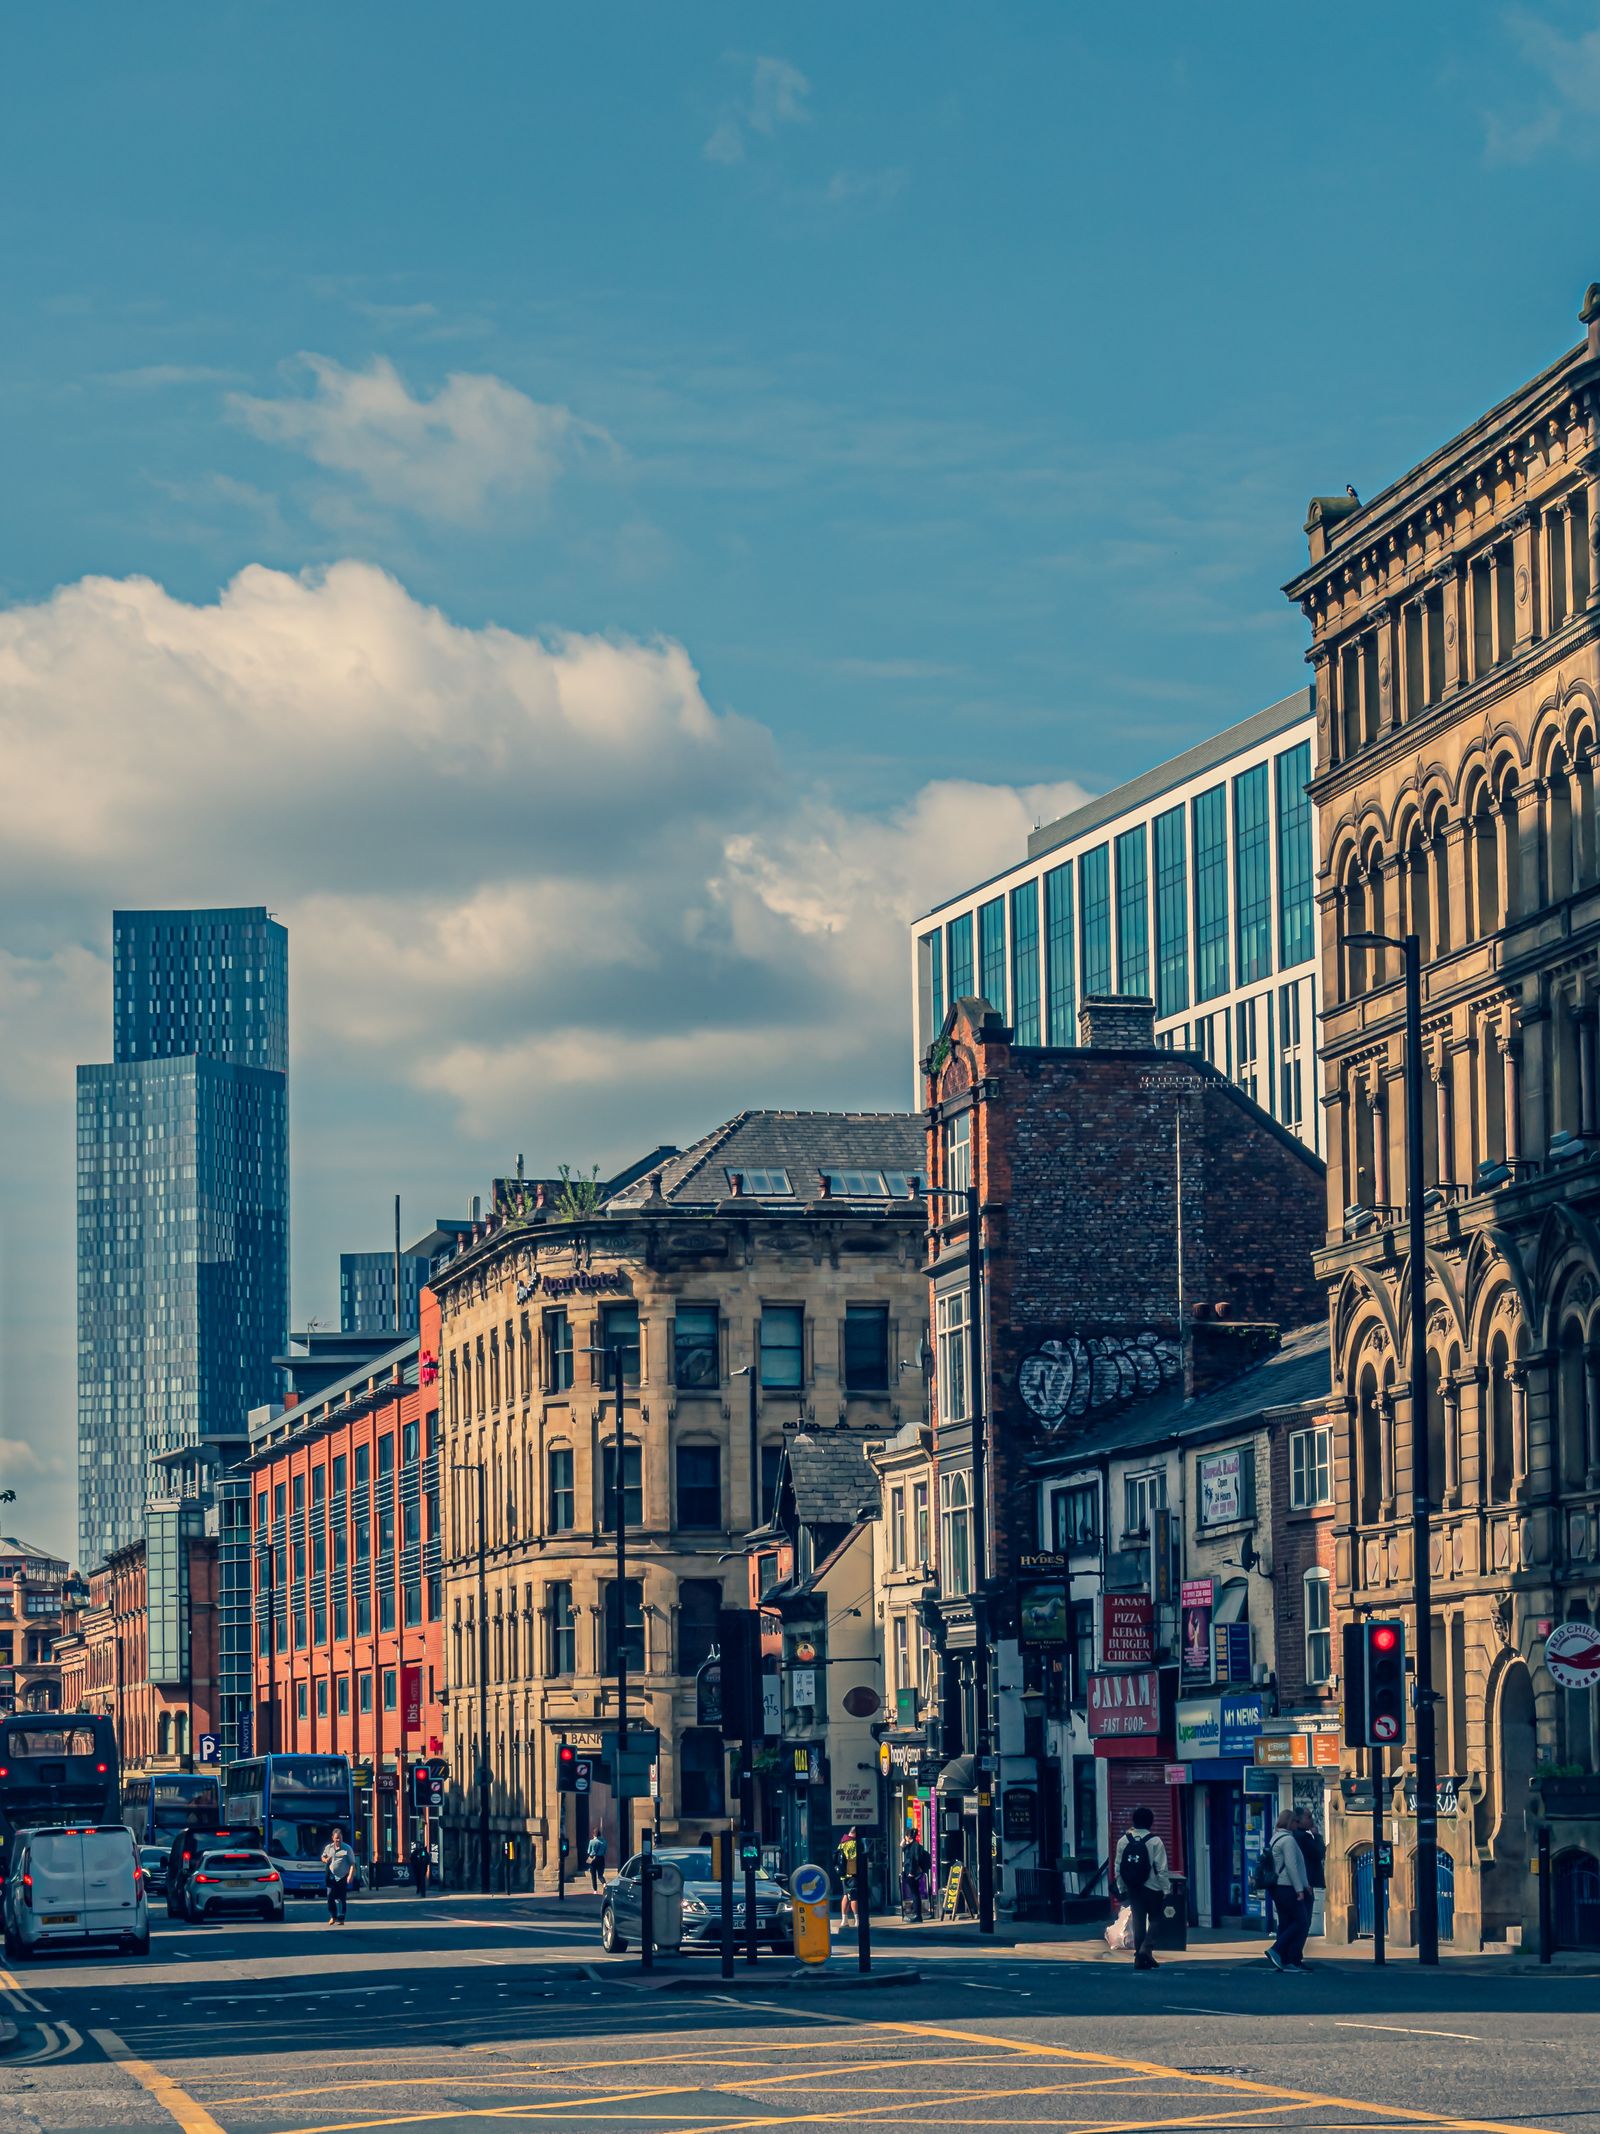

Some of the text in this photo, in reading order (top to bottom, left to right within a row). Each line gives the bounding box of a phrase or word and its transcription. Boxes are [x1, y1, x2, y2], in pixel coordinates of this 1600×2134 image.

[1020, 1553, 1065, 1565] HYDES
[1112, 1598, 1146, 1606] JANAM
[1114, 1613, 1142, 1623] PIZZA
[1112, 1627, 1146, 1637] KEBAB
[1550, 1625, 1600, 1649] RED CHILLI
[1109, 1639, 1150, 1649] BURGER
[1107, 1650, 1151, 1660] CHICKEN
[1092, 1674, 1150, 1709] JANAM
[763, 1694, 775, 1704] AT
[407, 1703, 418, 1722] ibis
[1224, 1707, 1259, 1727] M1 NEWS
[242, 1715, 250, 1753] NOVOTEL
[1178, 1720, 1219, 1743] Lycamobile
[571, 1733, 603, 1744] BANK
[203, 1741, 215, 1760] P
